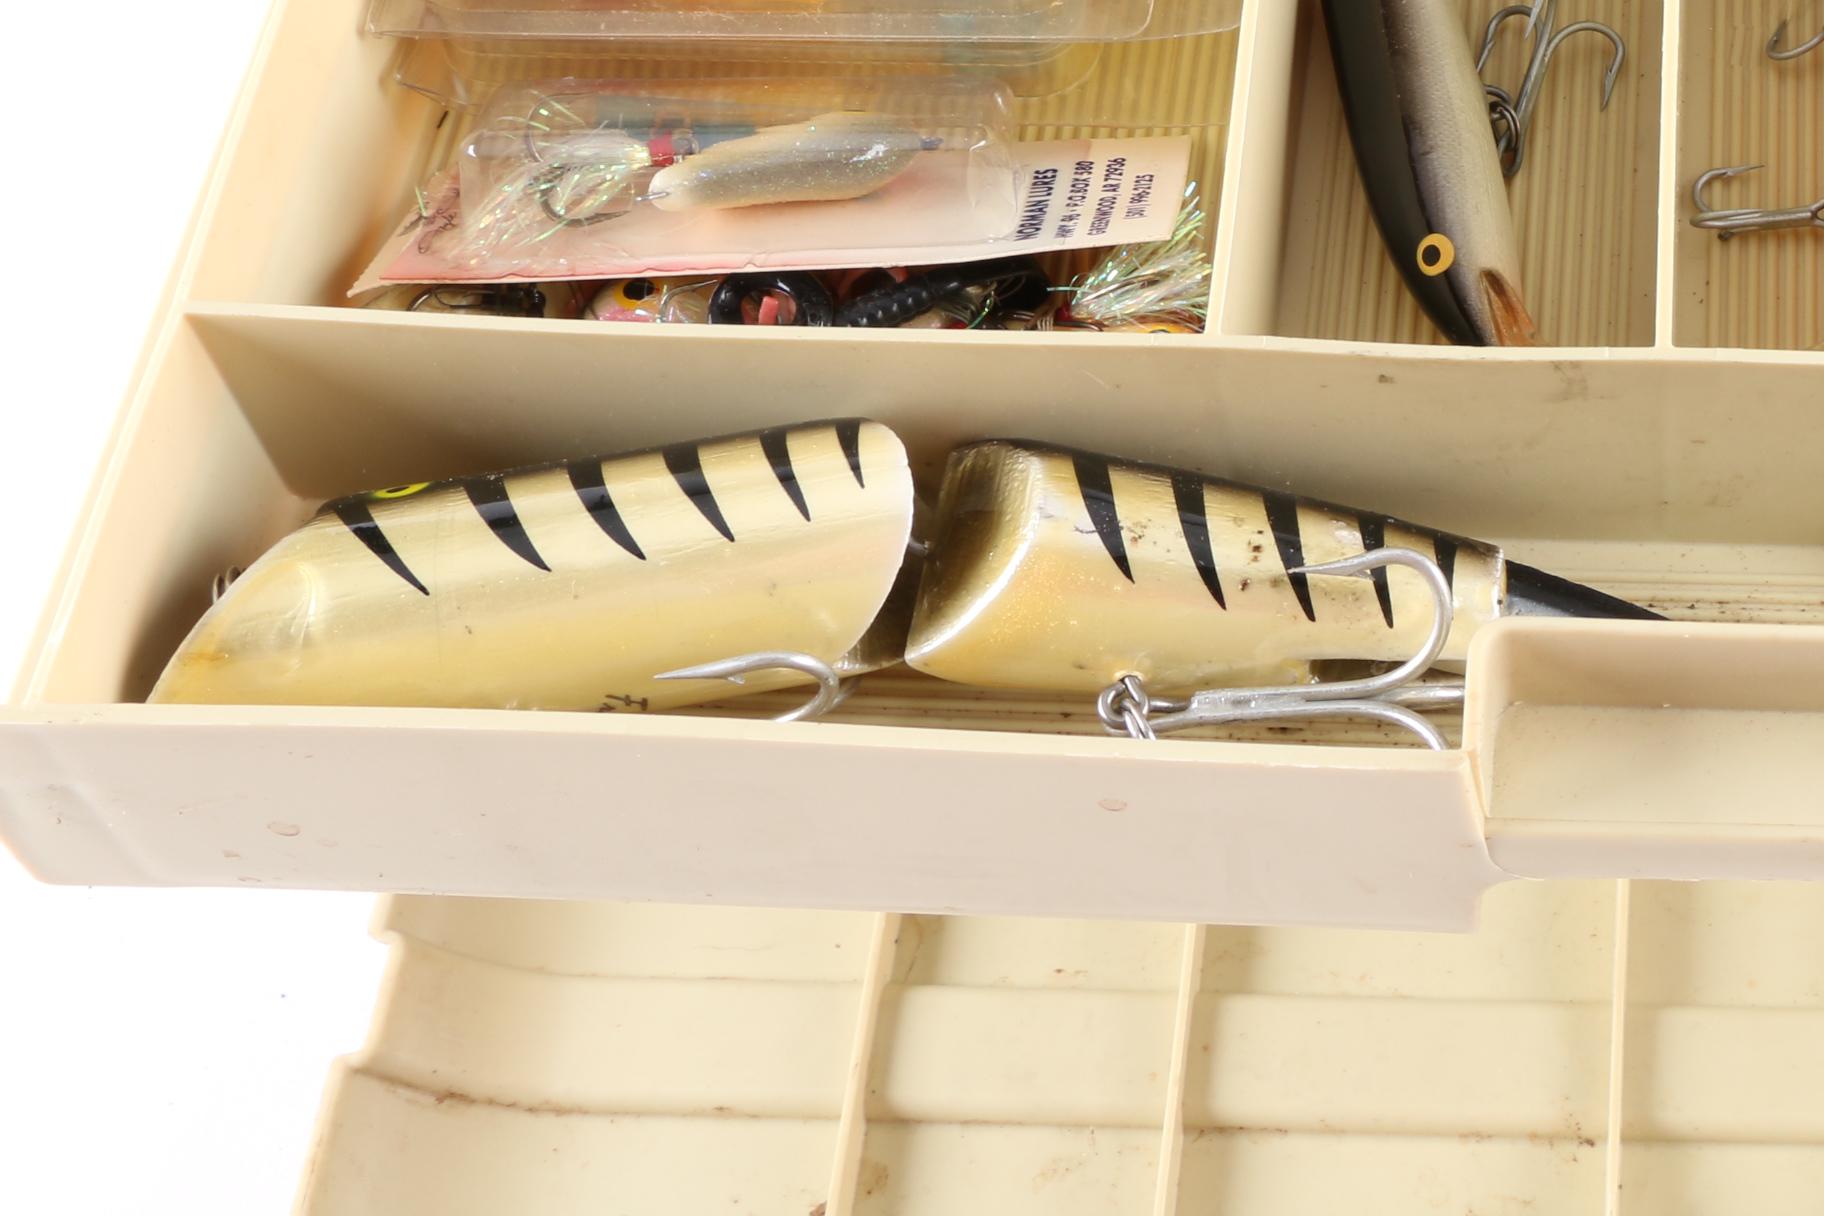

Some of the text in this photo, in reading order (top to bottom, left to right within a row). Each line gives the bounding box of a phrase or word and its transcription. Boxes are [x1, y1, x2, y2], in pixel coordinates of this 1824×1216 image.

[1014, 168, 1058, 241] NORMAN LURES
[1075, 161, 1095, 176] 580
[1087, 157, 1127, 236] GREENWOOD, AR 72936
